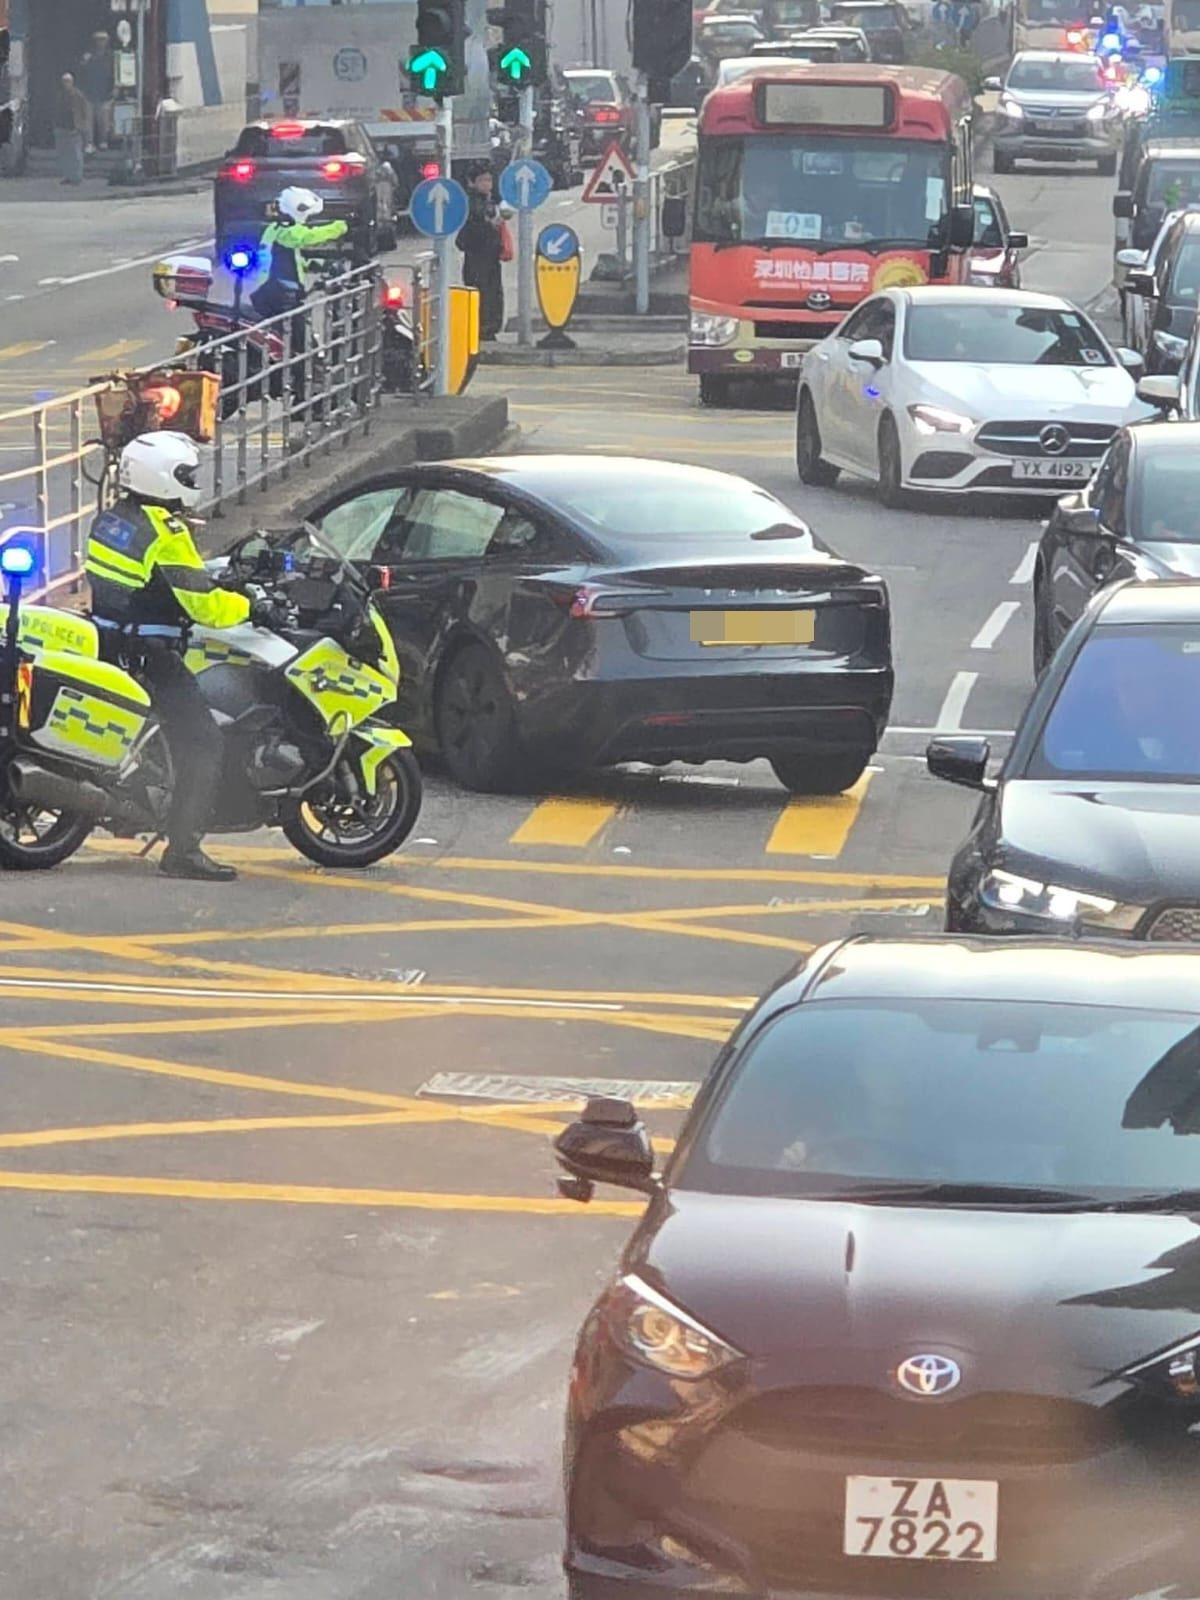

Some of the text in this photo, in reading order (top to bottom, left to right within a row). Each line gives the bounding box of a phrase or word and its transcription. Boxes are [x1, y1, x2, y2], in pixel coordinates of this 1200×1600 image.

[1022, 461, 1084, 477] YX 4192
[890, 1479, 952, 1519] ZA
[855, 1516, 985, 1559] 7822
